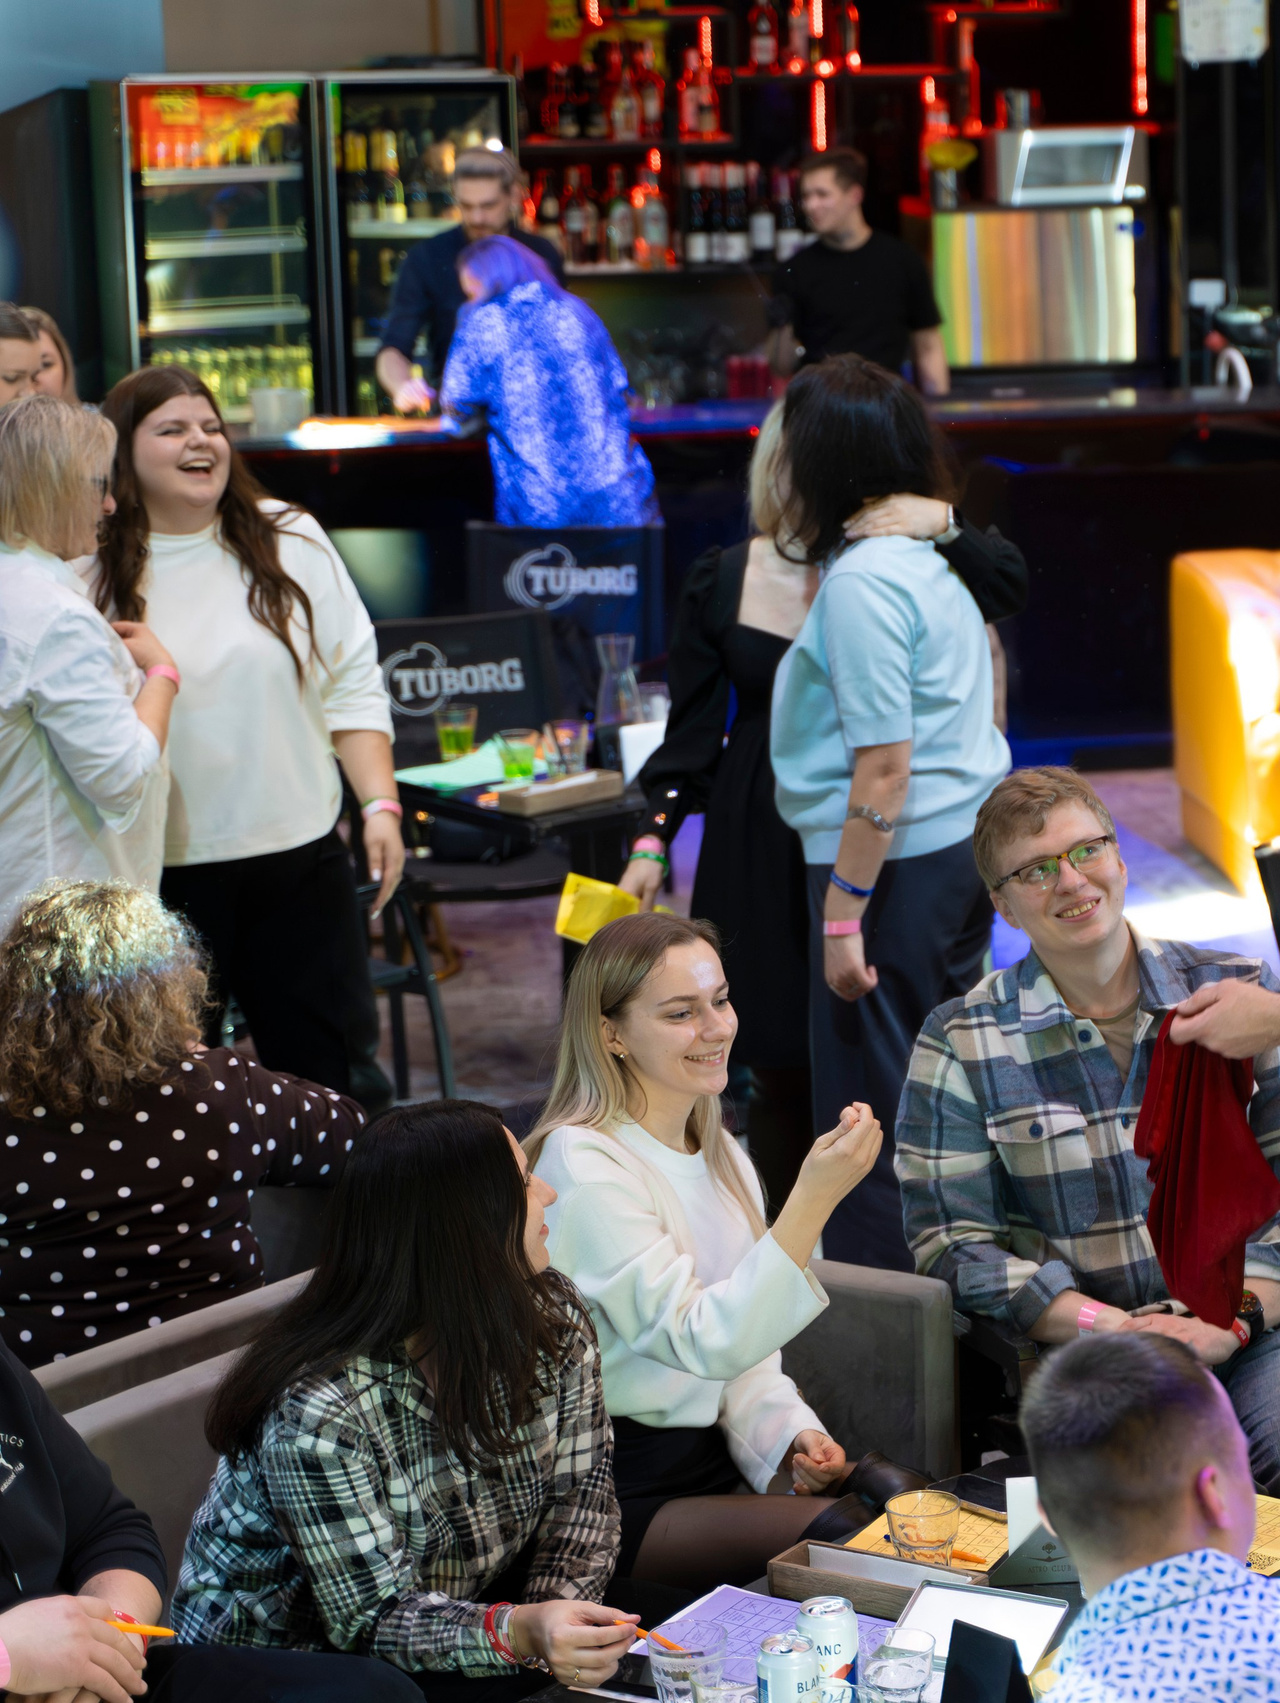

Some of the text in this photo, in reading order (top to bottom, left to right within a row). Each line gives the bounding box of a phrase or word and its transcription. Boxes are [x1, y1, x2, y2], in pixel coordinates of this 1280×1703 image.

[526, 563, 638, 597] TUBORG
[392, 657, 525, 702] TUBORG
[1027, 1564, 1072, 1573] ASTRO CLUB
